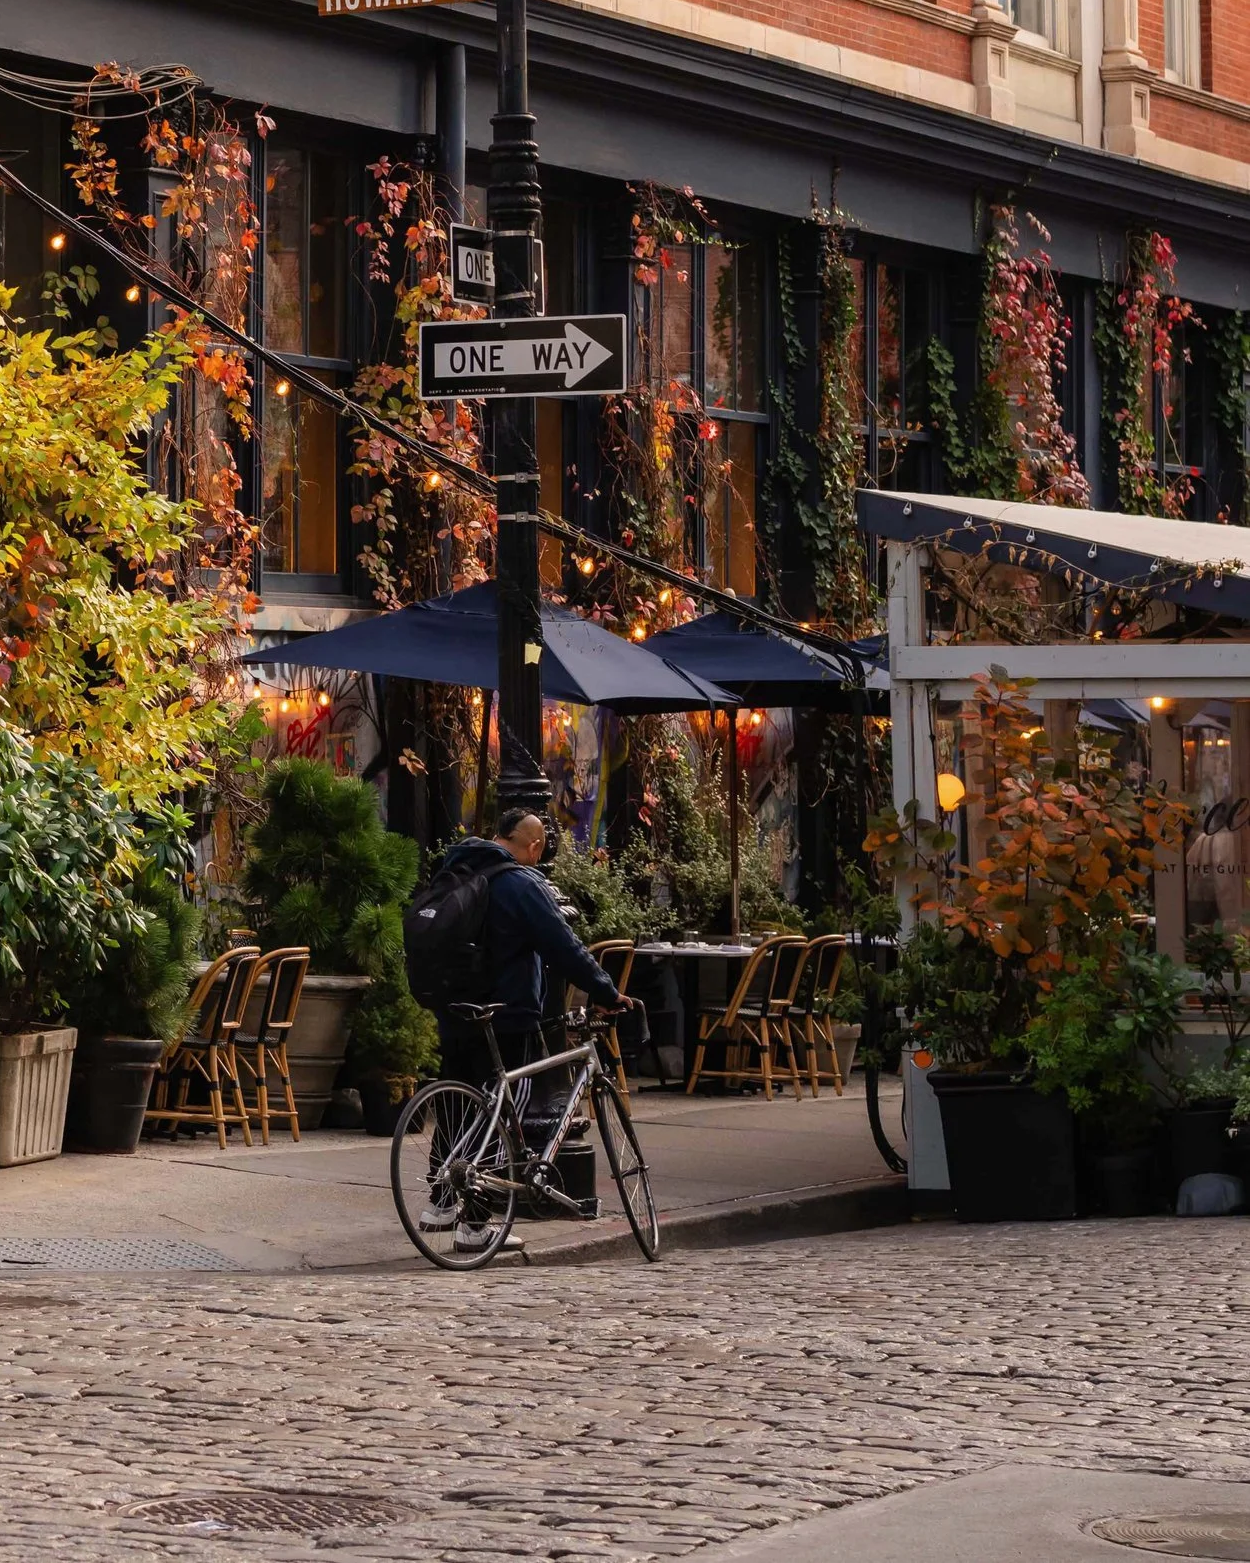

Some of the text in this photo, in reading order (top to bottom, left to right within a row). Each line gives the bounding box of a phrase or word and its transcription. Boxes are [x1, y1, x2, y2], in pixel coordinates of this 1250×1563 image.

[465, 251, 491, 282] ONE
[450, 342, 591, 373] ONE WAY
